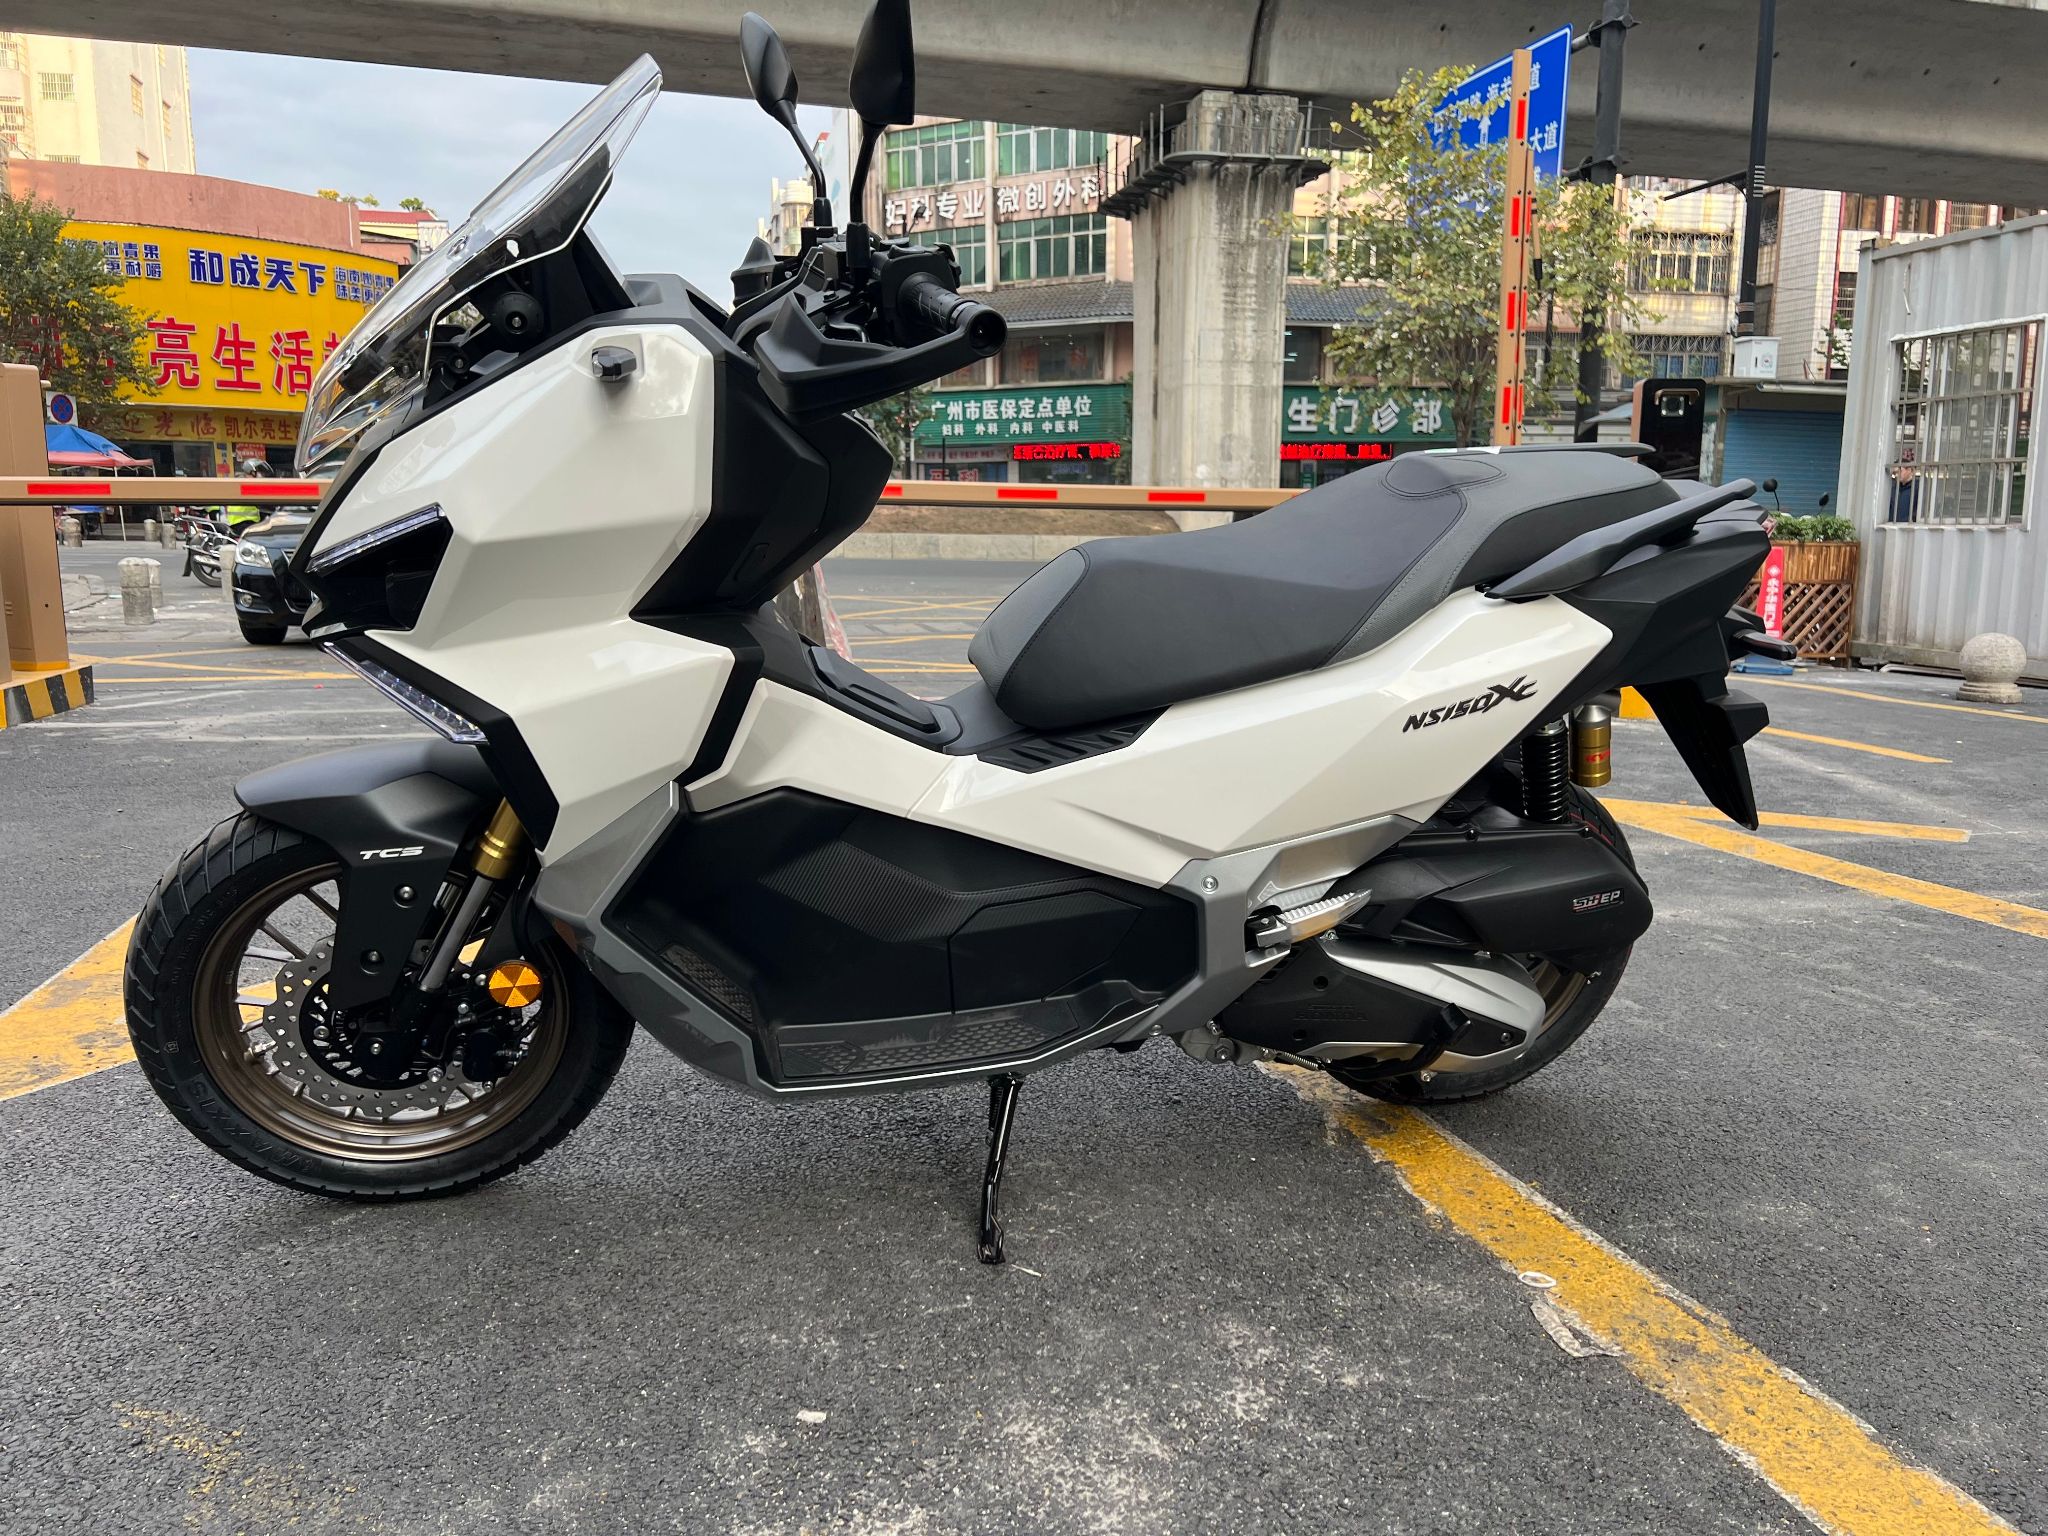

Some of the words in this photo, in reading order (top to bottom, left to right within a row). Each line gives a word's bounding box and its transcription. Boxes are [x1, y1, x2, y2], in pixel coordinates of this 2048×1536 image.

[885, 188, 984, 227] 妇科专业
[997, 174, 1102, 214] 微创外科
[187, 247, 327, 295] 和成天下
[931, 396, 1092, 421] 广州市医保定点单位
[942, 423, 965, 436] 妇科
[975, 422, 998, 436] 外科
[1041, 419, 1079, 433] 中医科
[360, 846, 425, 860] TCS
